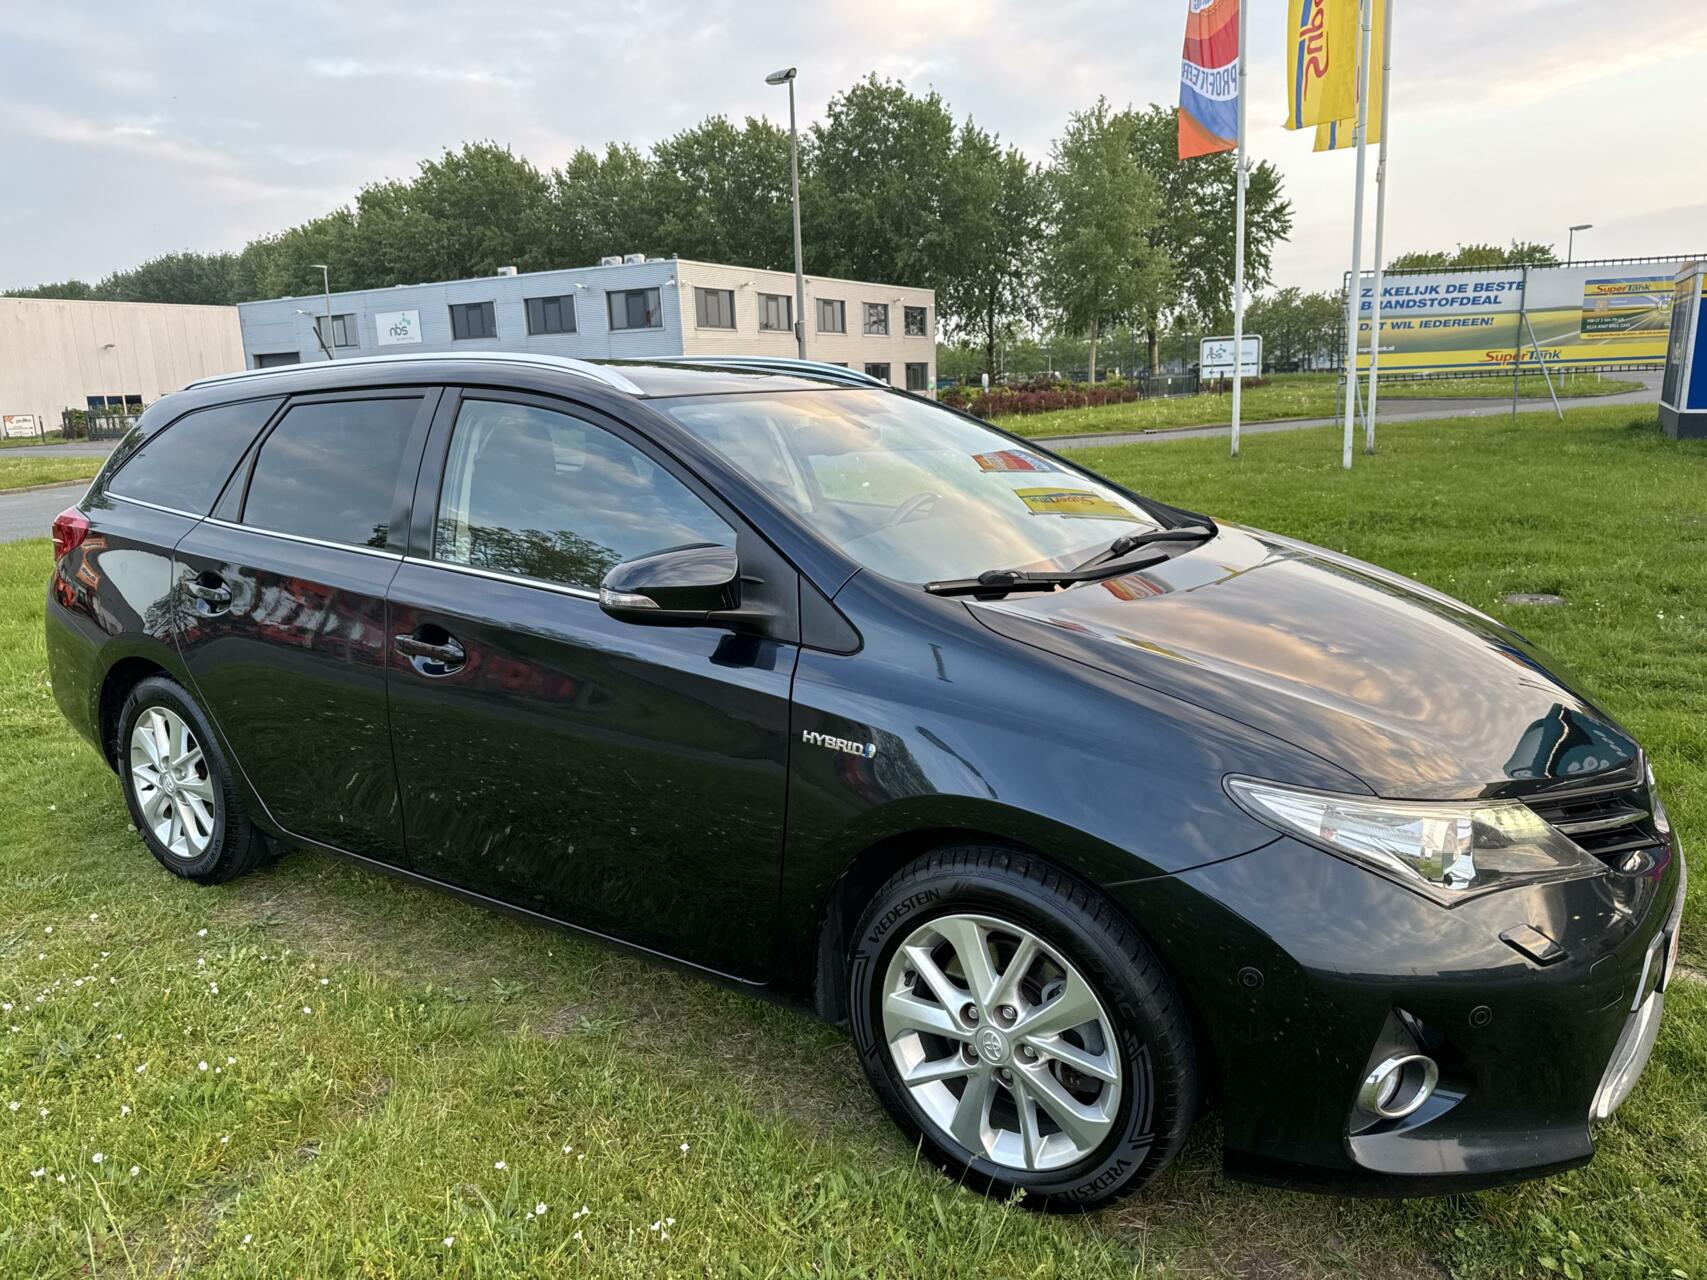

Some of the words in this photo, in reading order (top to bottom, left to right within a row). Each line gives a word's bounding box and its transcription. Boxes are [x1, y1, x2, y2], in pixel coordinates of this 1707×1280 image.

[1361, 285, 1440, 298] ZKELIJK
[1445, 283, 1469, 294] DE
[1473, 281, 1525, 293] BESTE
[1596, 283, 1651, 295] SuperTank
[1360, 321, 1387, 331] DT
[1391, 320, 1415, 330] WIL
[1419, 317, 1494, 329] IEDEREEN!
[802, 730, 864, 756] HYBRID
[868, 888, 941, 944] VREDESTEIN
